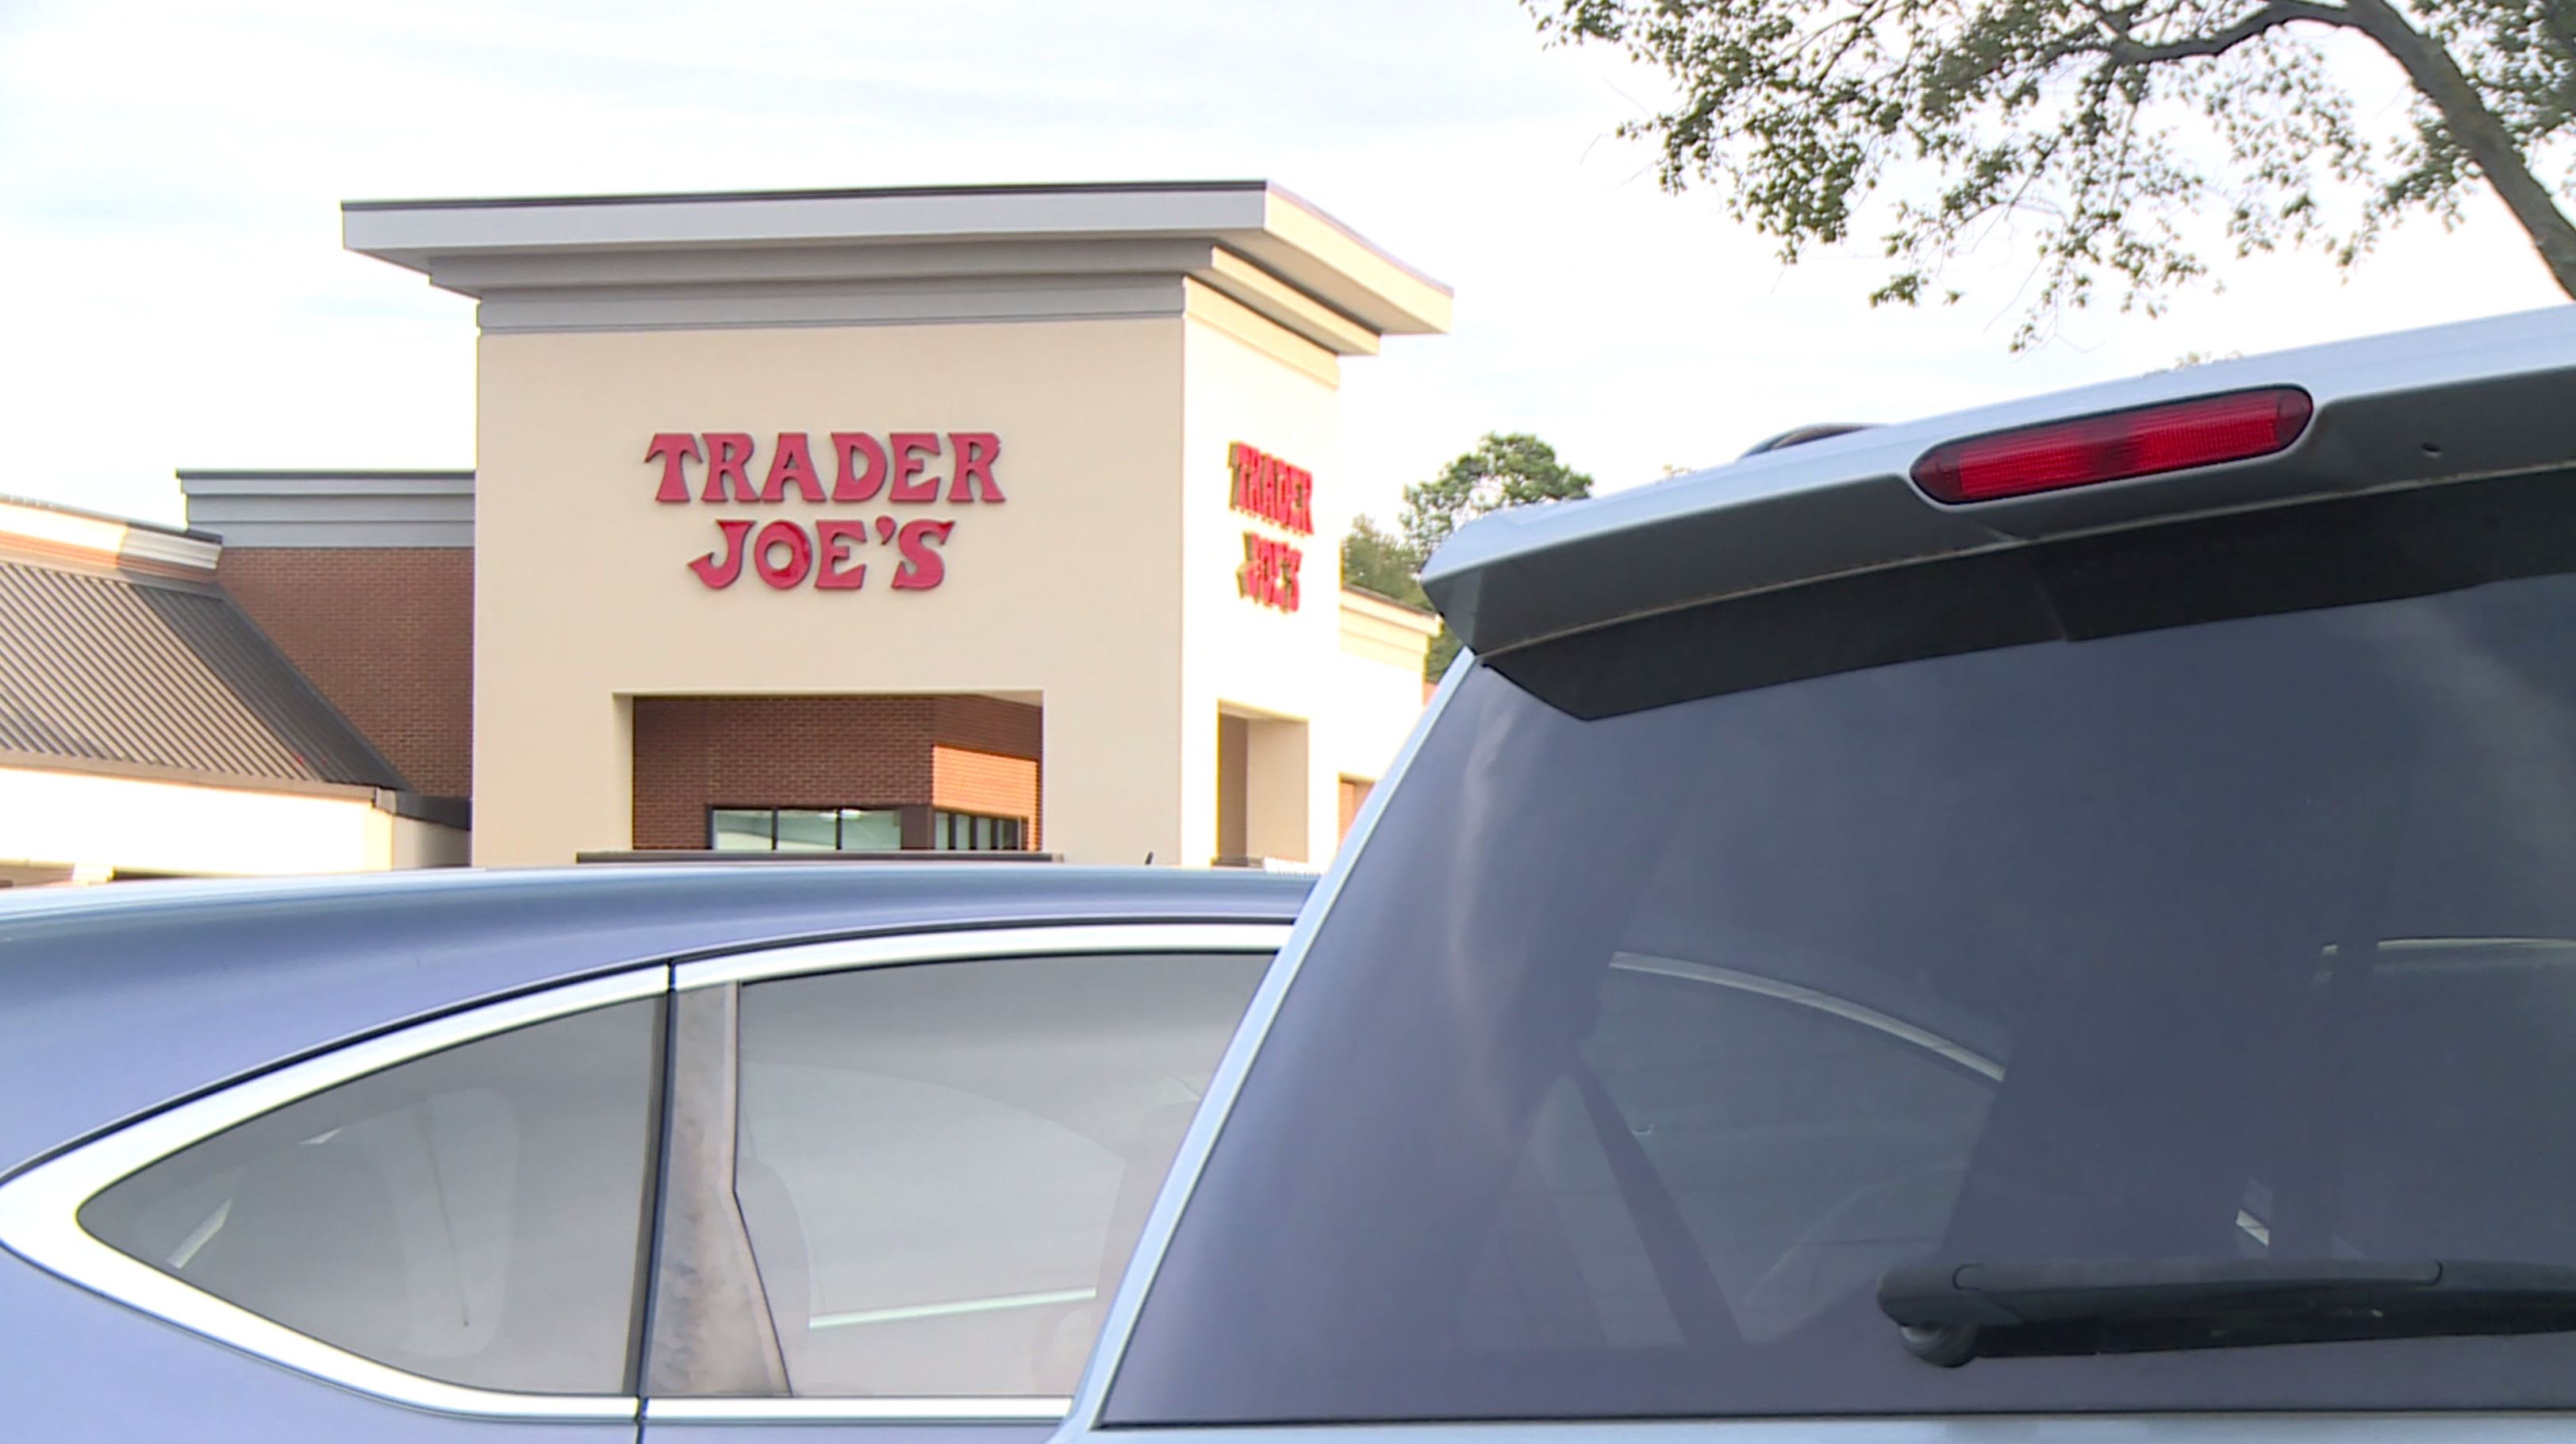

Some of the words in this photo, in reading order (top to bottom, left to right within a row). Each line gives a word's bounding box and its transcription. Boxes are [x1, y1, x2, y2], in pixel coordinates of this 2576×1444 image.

[644, 432, 1006, 503] TRADER
[1227, 441, 1314, 537] TRADER
[687, 516, 955, 590] JOE'S
